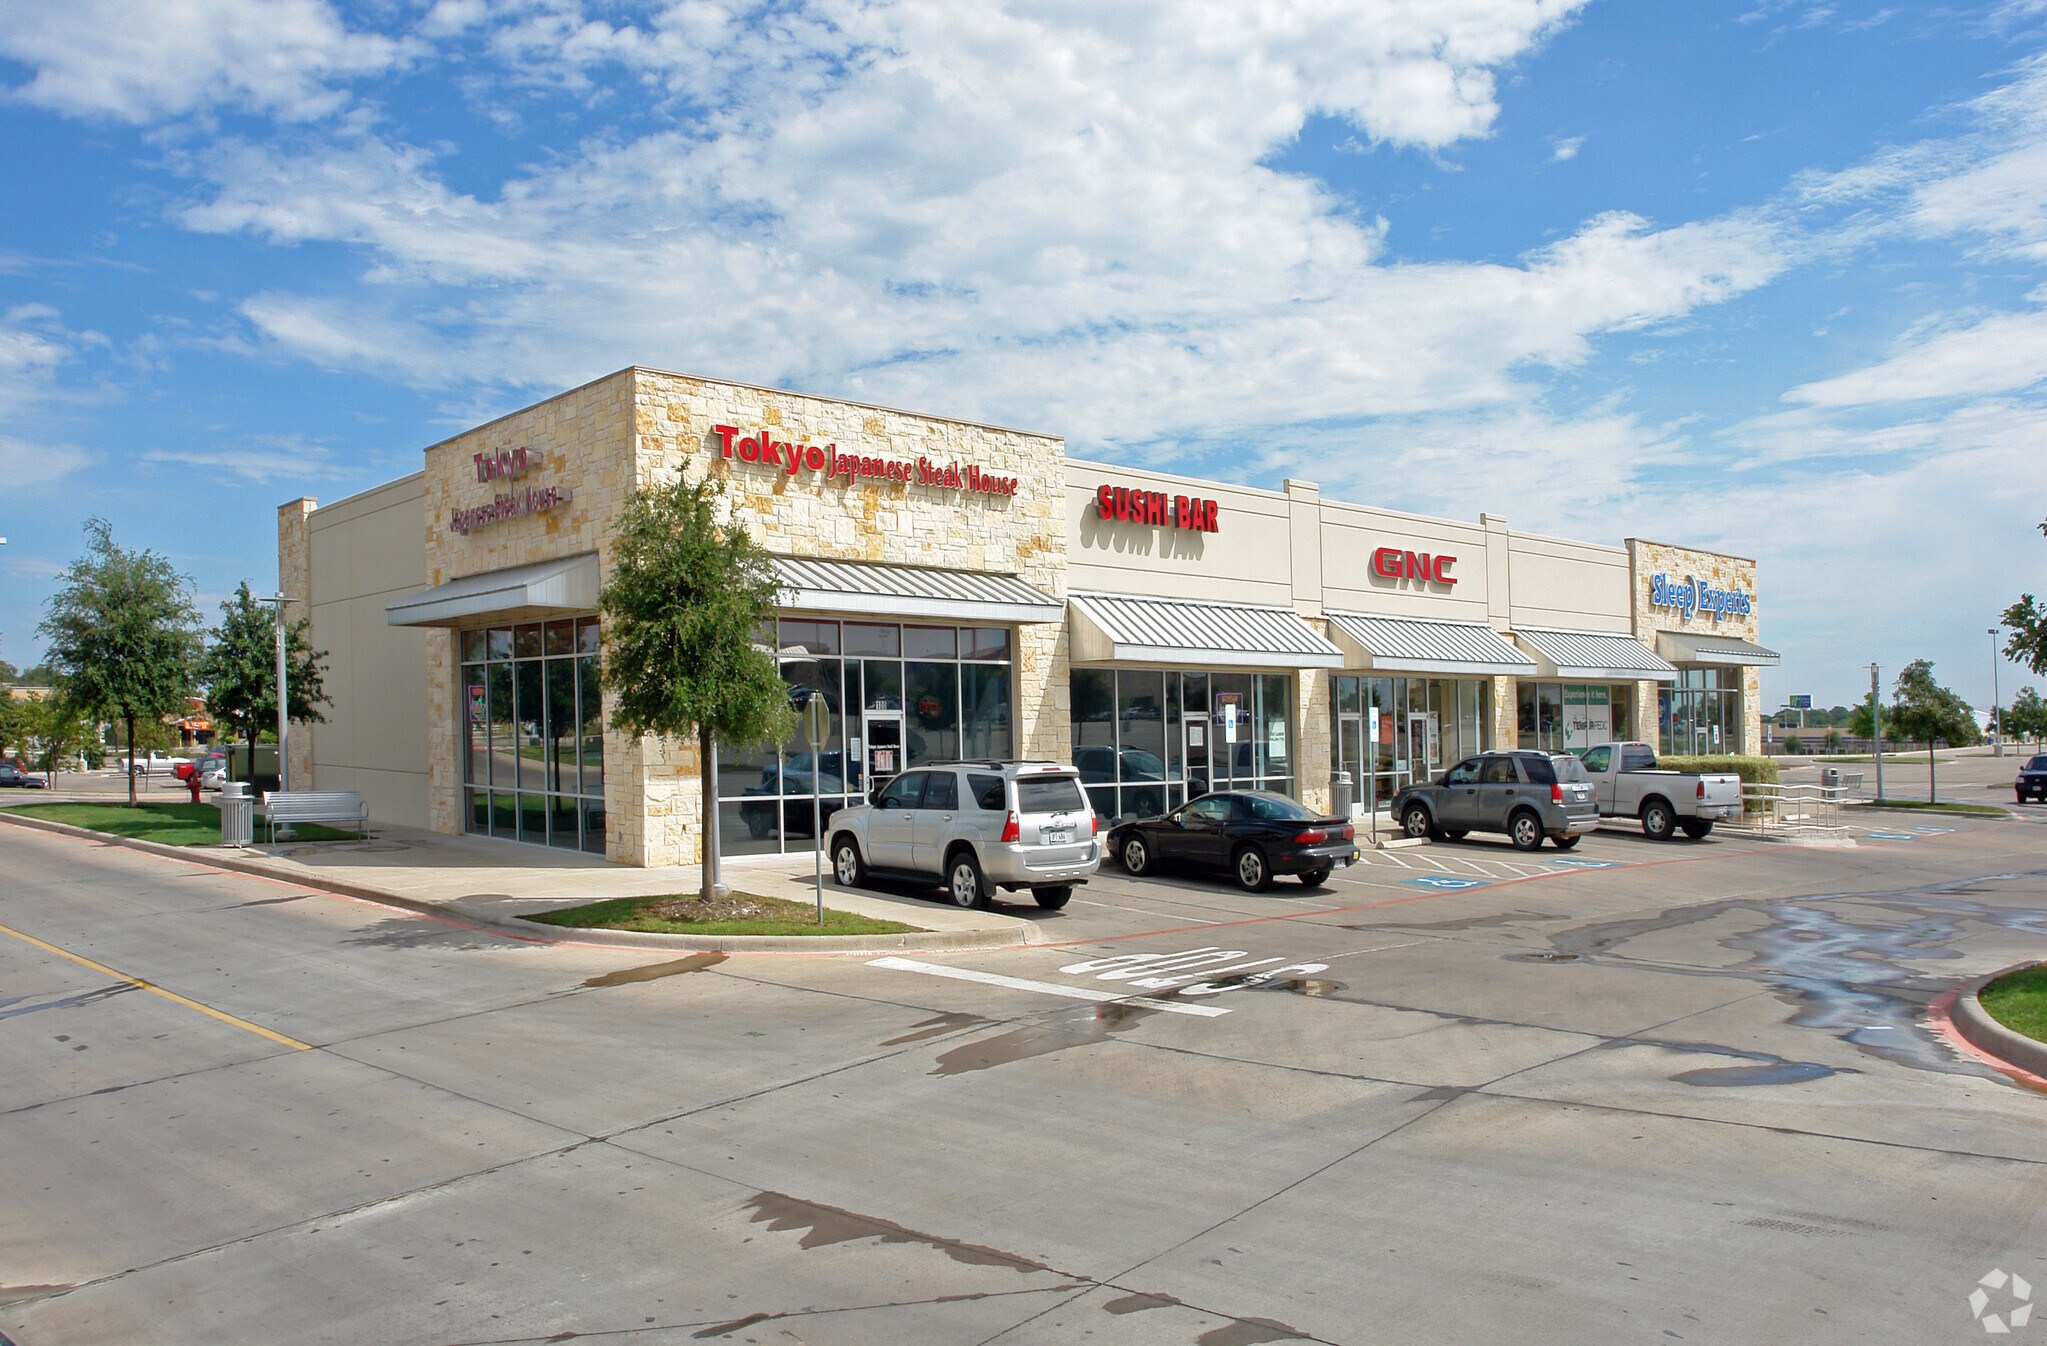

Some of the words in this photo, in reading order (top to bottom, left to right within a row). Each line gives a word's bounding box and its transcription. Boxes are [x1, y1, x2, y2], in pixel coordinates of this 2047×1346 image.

[473, 446, 528, 483] Tokyo
[715, 424, 826, 475] Tokyo
[827, 443, 914, 485] Japanese
[917, 456, 964, 489] Steak
[966, 464, 1018, 496] House
[1097, 484, 1169, 527] SUSHI
[1174, 494, 1219, 533] BAR
[1374, 547, 1458, 584] GNC
[1699, 580, 1751, 622] Experts
[1059, 946, 1330, 995] STOP
